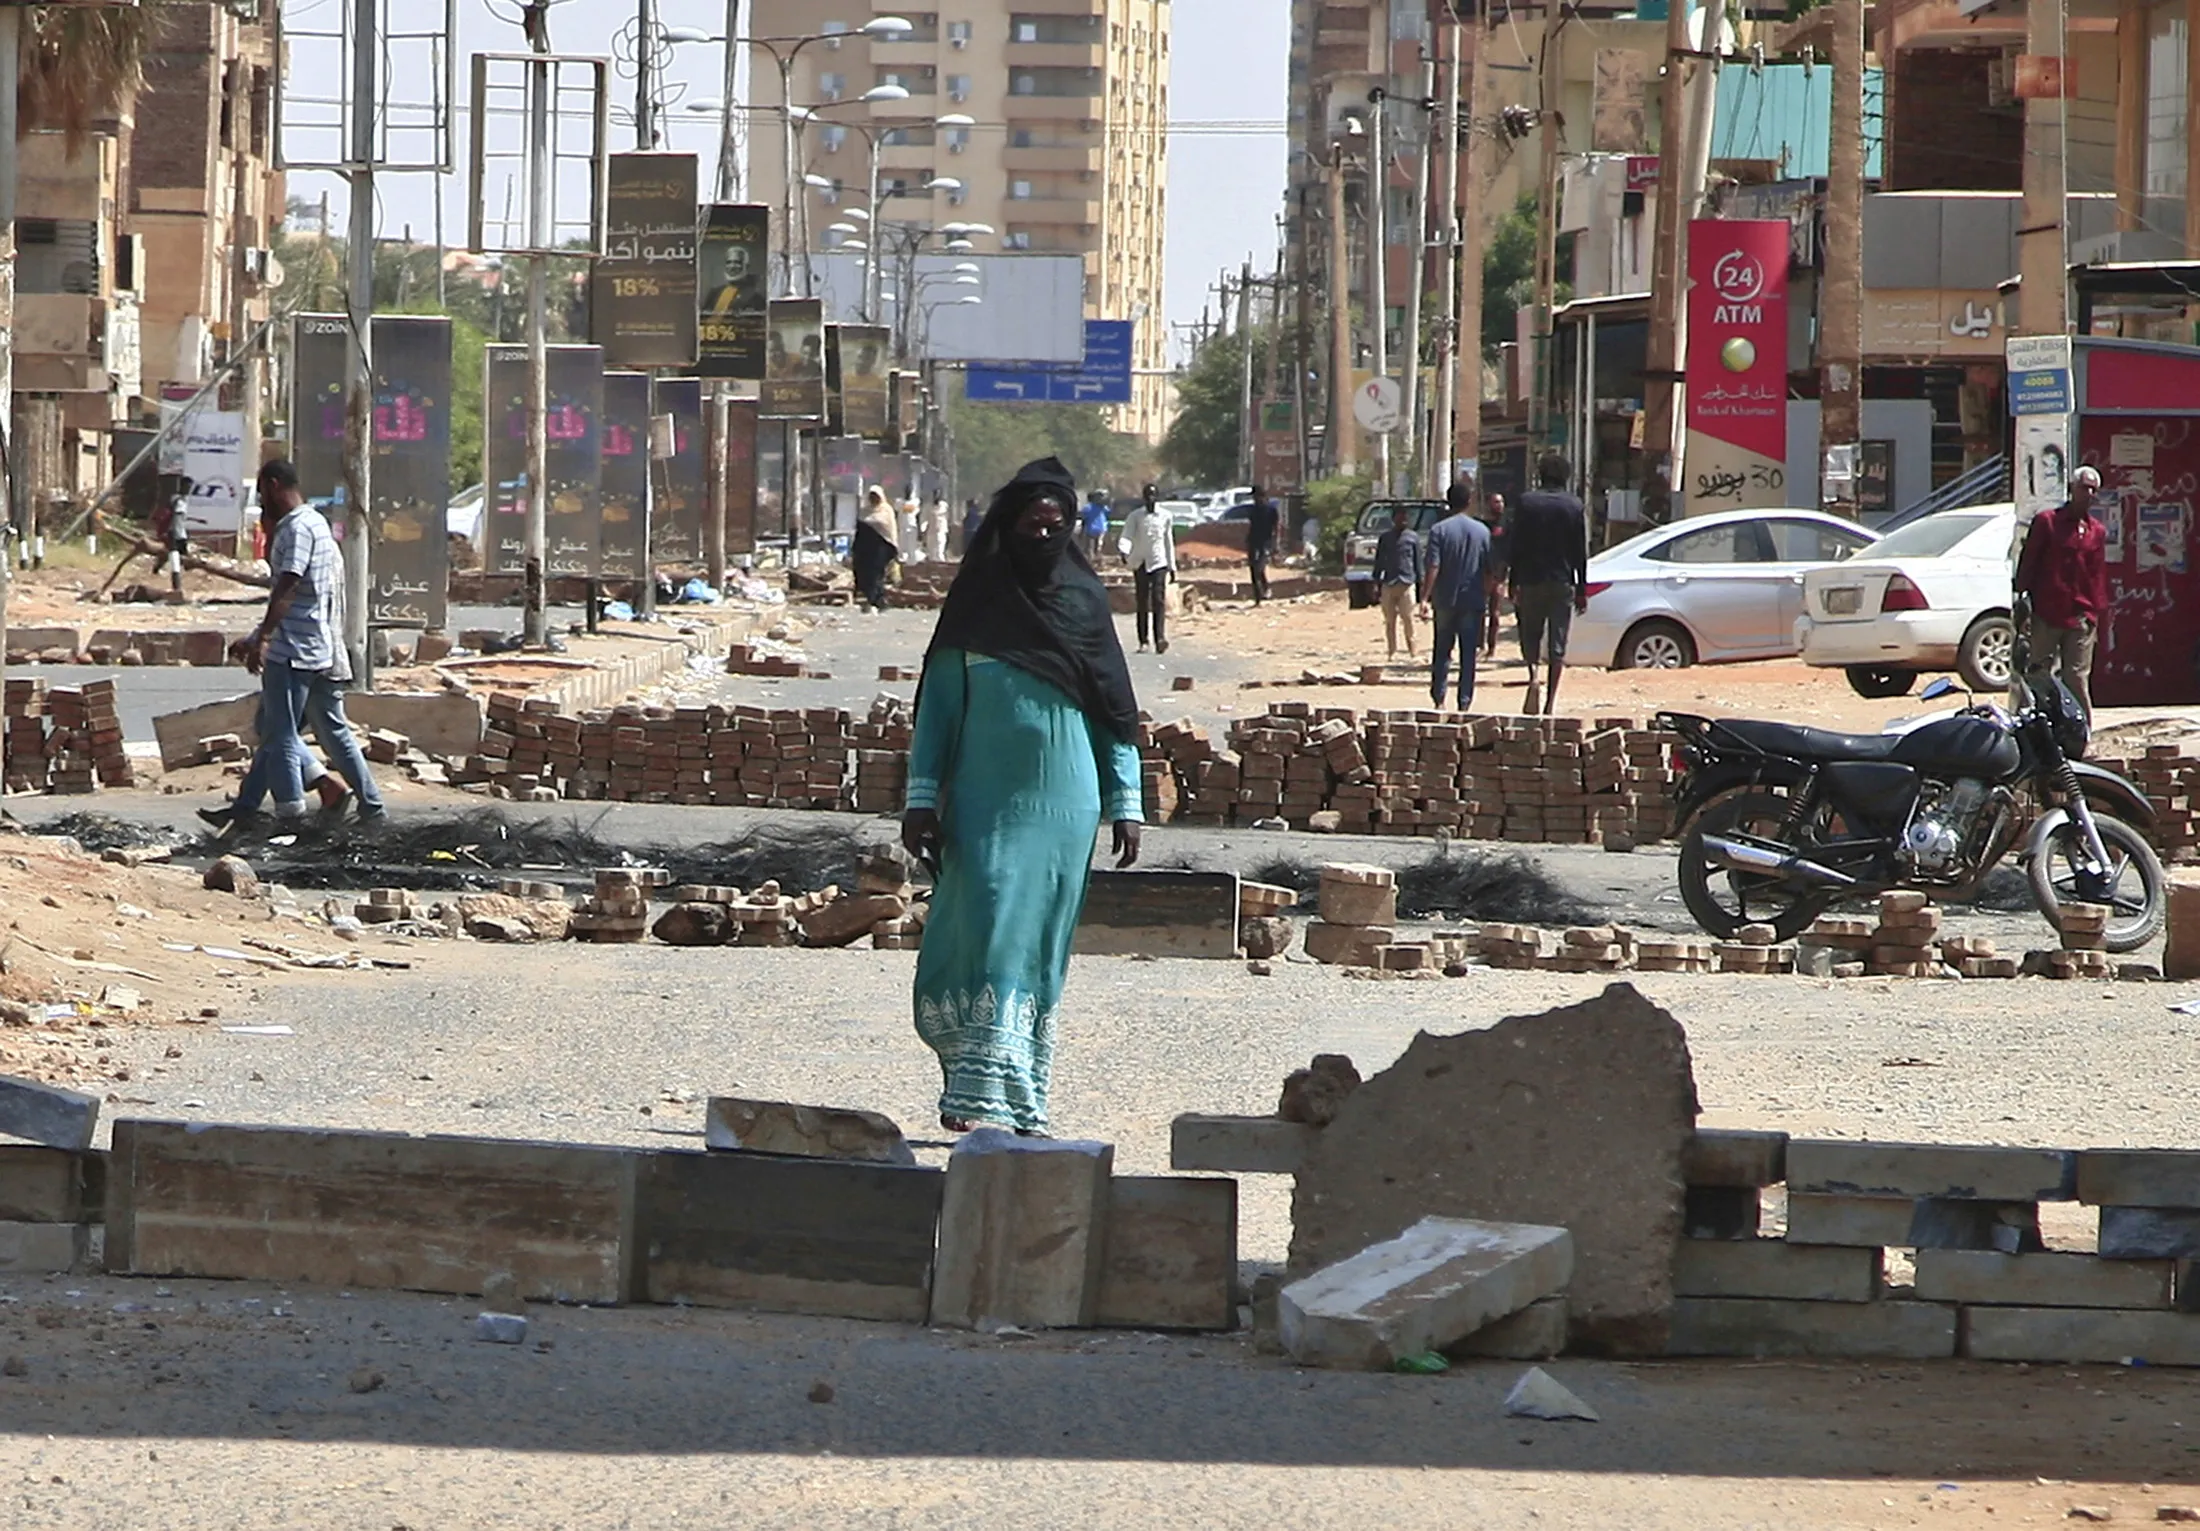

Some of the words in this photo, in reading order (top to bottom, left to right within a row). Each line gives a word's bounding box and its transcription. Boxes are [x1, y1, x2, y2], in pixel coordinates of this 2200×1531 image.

[642, 240, 695, 265] بنمو
[612, 279, 660, 297] 18%
[1724, 267, 1754, 287] 24
[1713, 305, 1762, 324] ATM
[1751, 464, 1784, 490] 30
[381, 573, 430, 597] عيش
